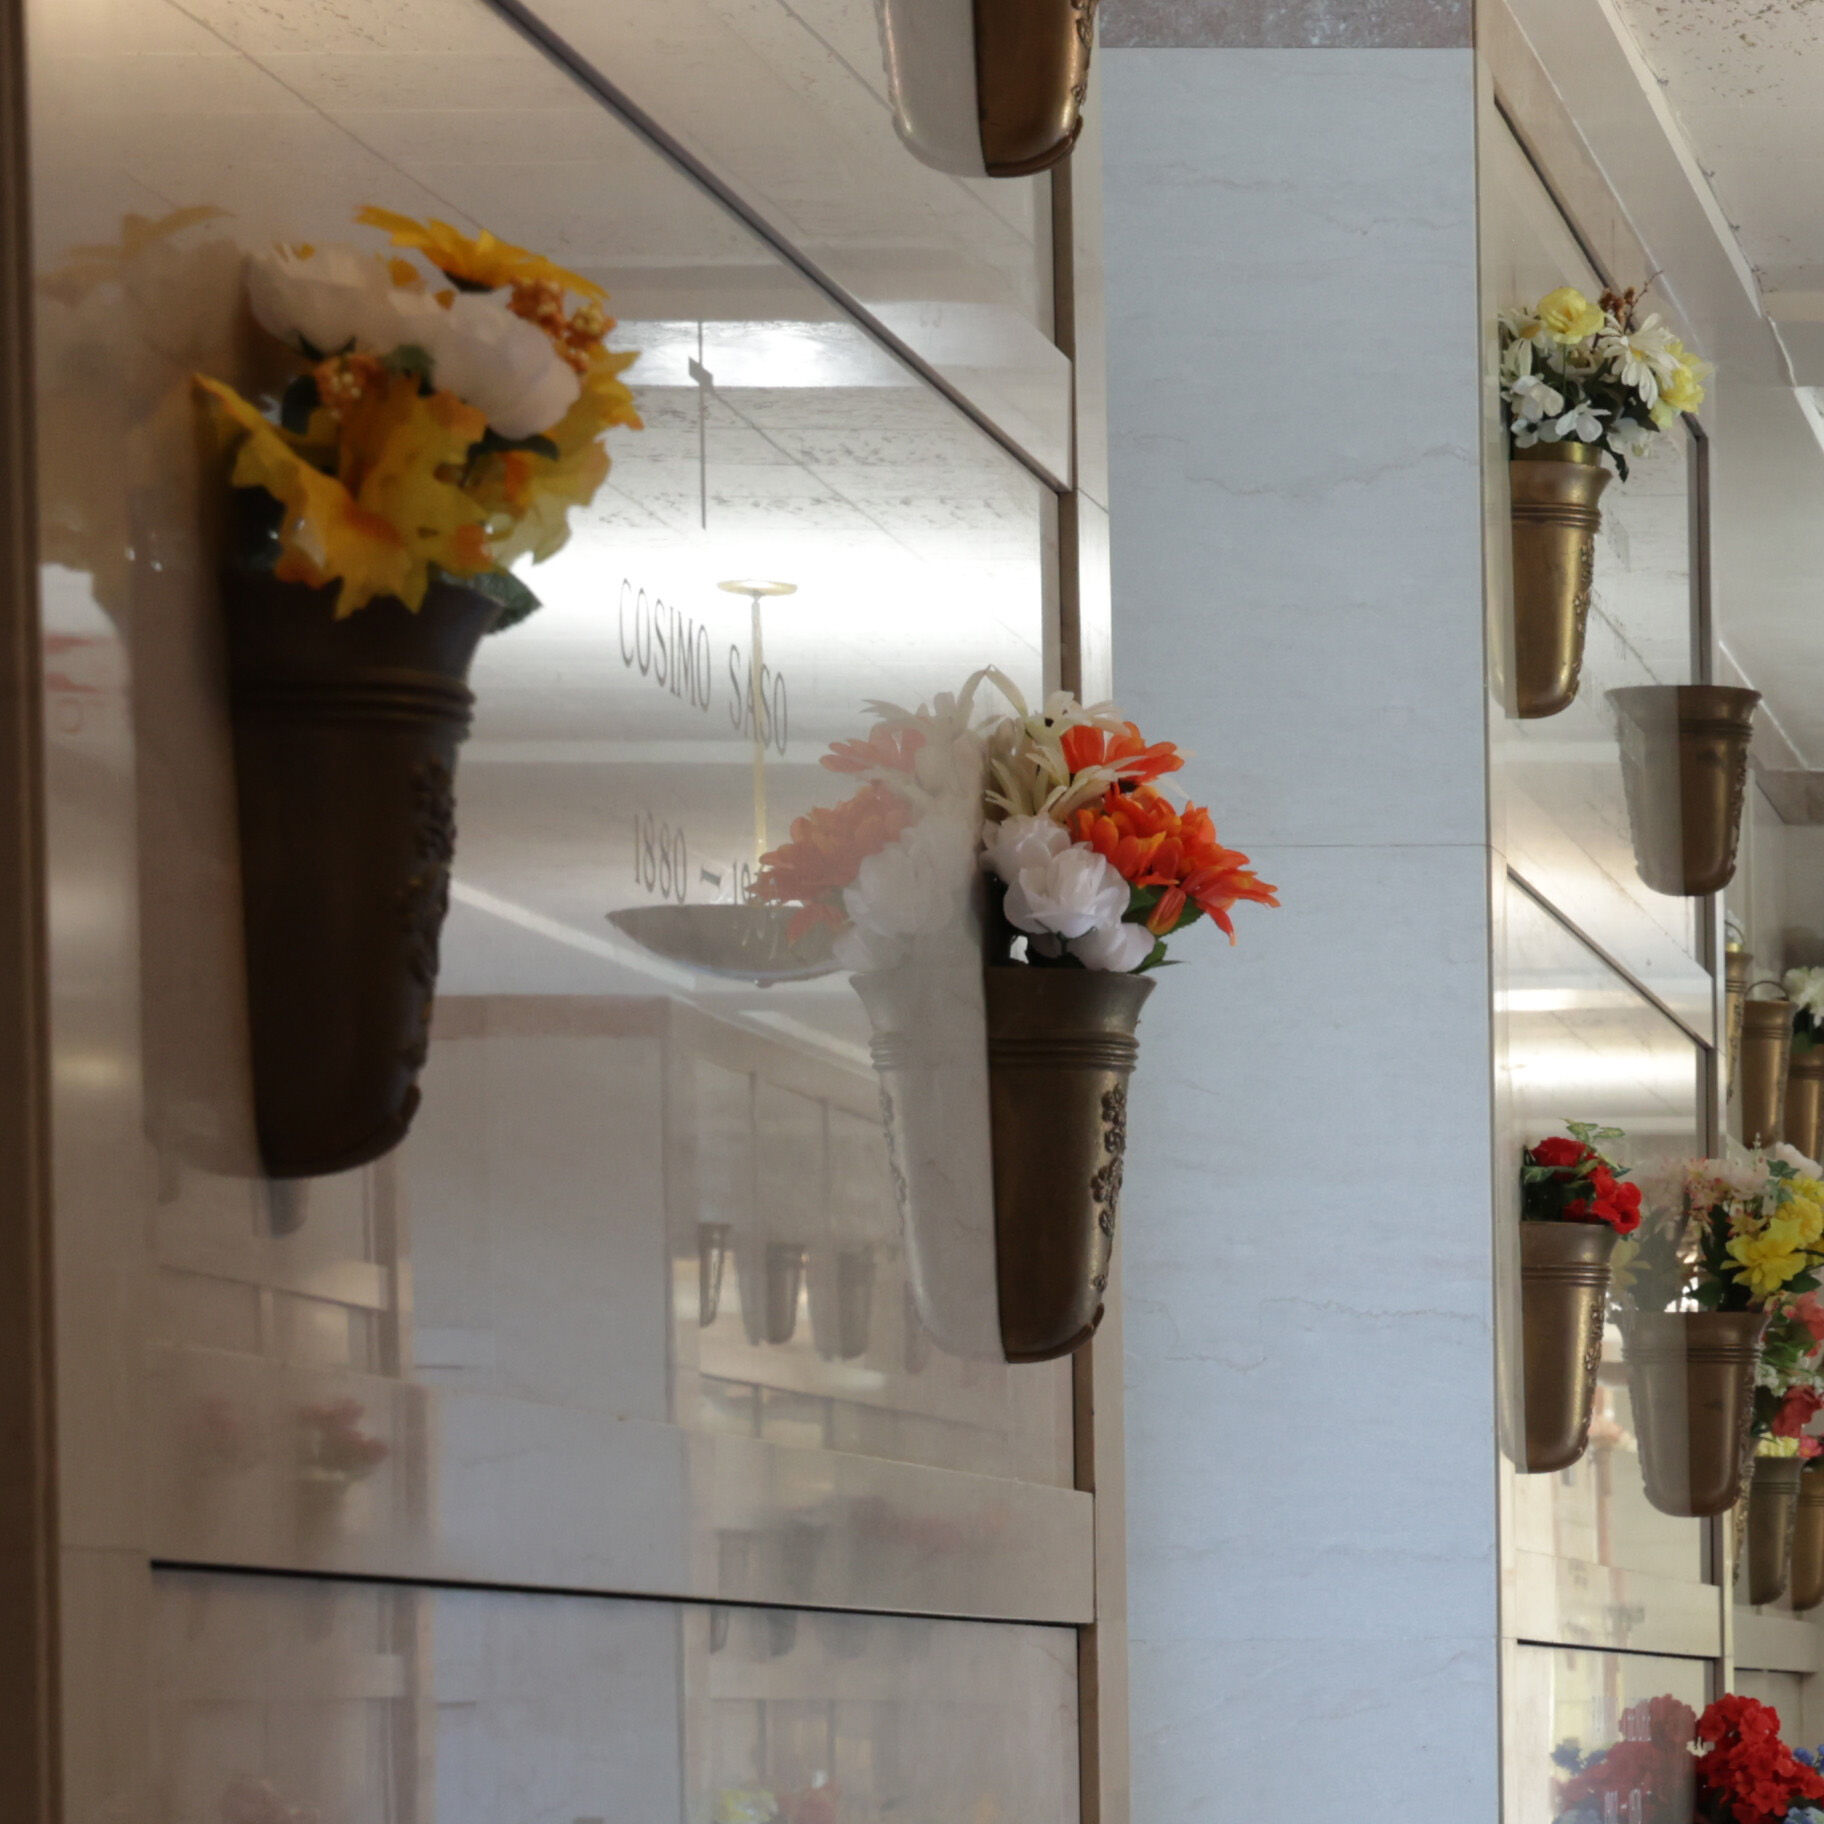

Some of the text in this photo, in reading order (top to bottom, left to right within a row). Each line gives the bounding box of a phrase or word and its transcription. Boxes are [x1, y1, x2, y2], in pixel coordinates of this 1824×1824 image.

[618, 577, 788, 757] COSIMO SASO
[633, 811, 688, 904] 1880
